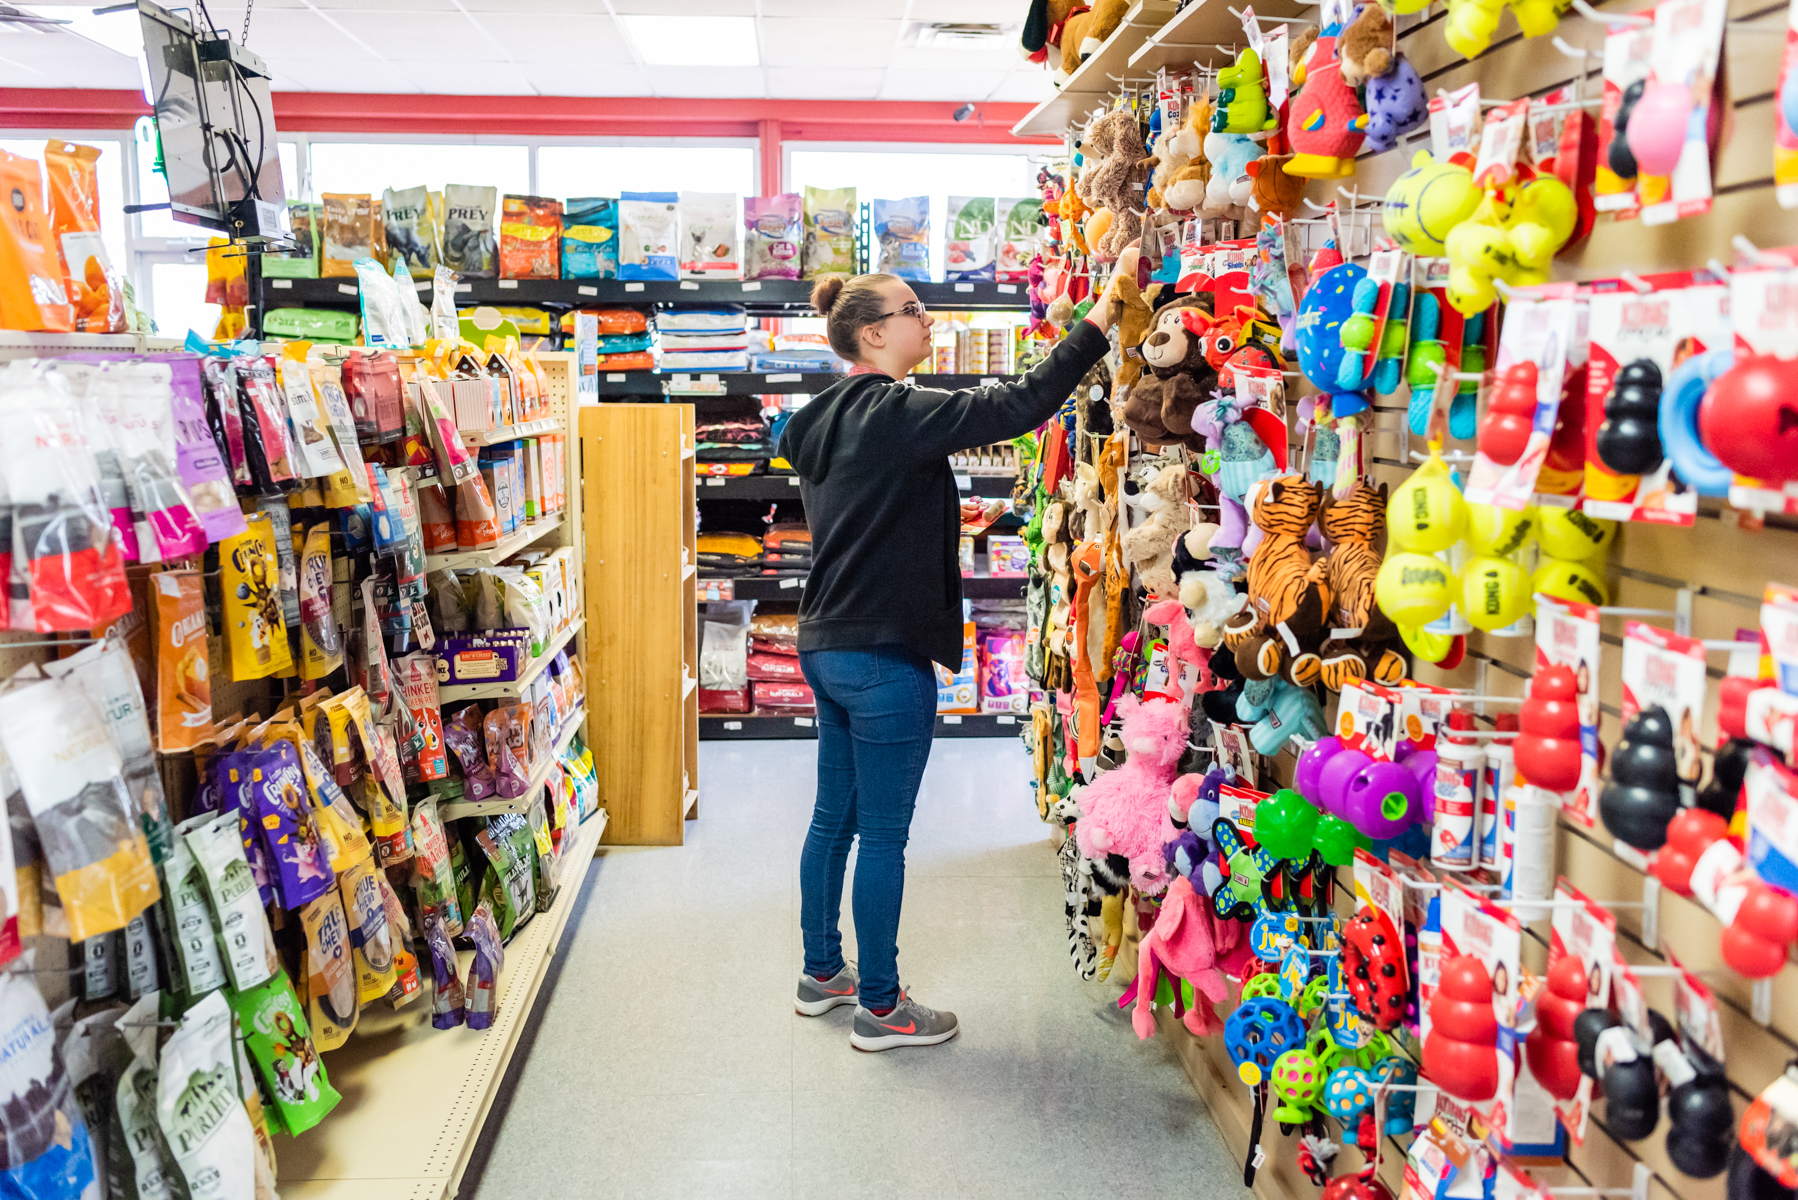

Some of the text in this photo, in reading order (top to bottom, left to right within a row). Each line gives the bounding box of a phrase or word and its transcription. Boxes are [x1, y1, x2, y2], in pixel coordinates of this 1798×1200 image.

[386, 207, 421, 222] PREY
[447, 207, 489, 222] PREY
[1227, 251, 1245, 263] KONG
[690, 383, 719, 393] FREE
[411, 600, 426, 618] BIG
[769, 689, 804, 697] NATURALS
[385, 805, 394, 814] NO
[343, 832, 353, 843] NO
[362, 972, 372, 982] NO
[322, 1026, 333, 1036] NO
[0, 1019, 51, 1063] ATURAL
